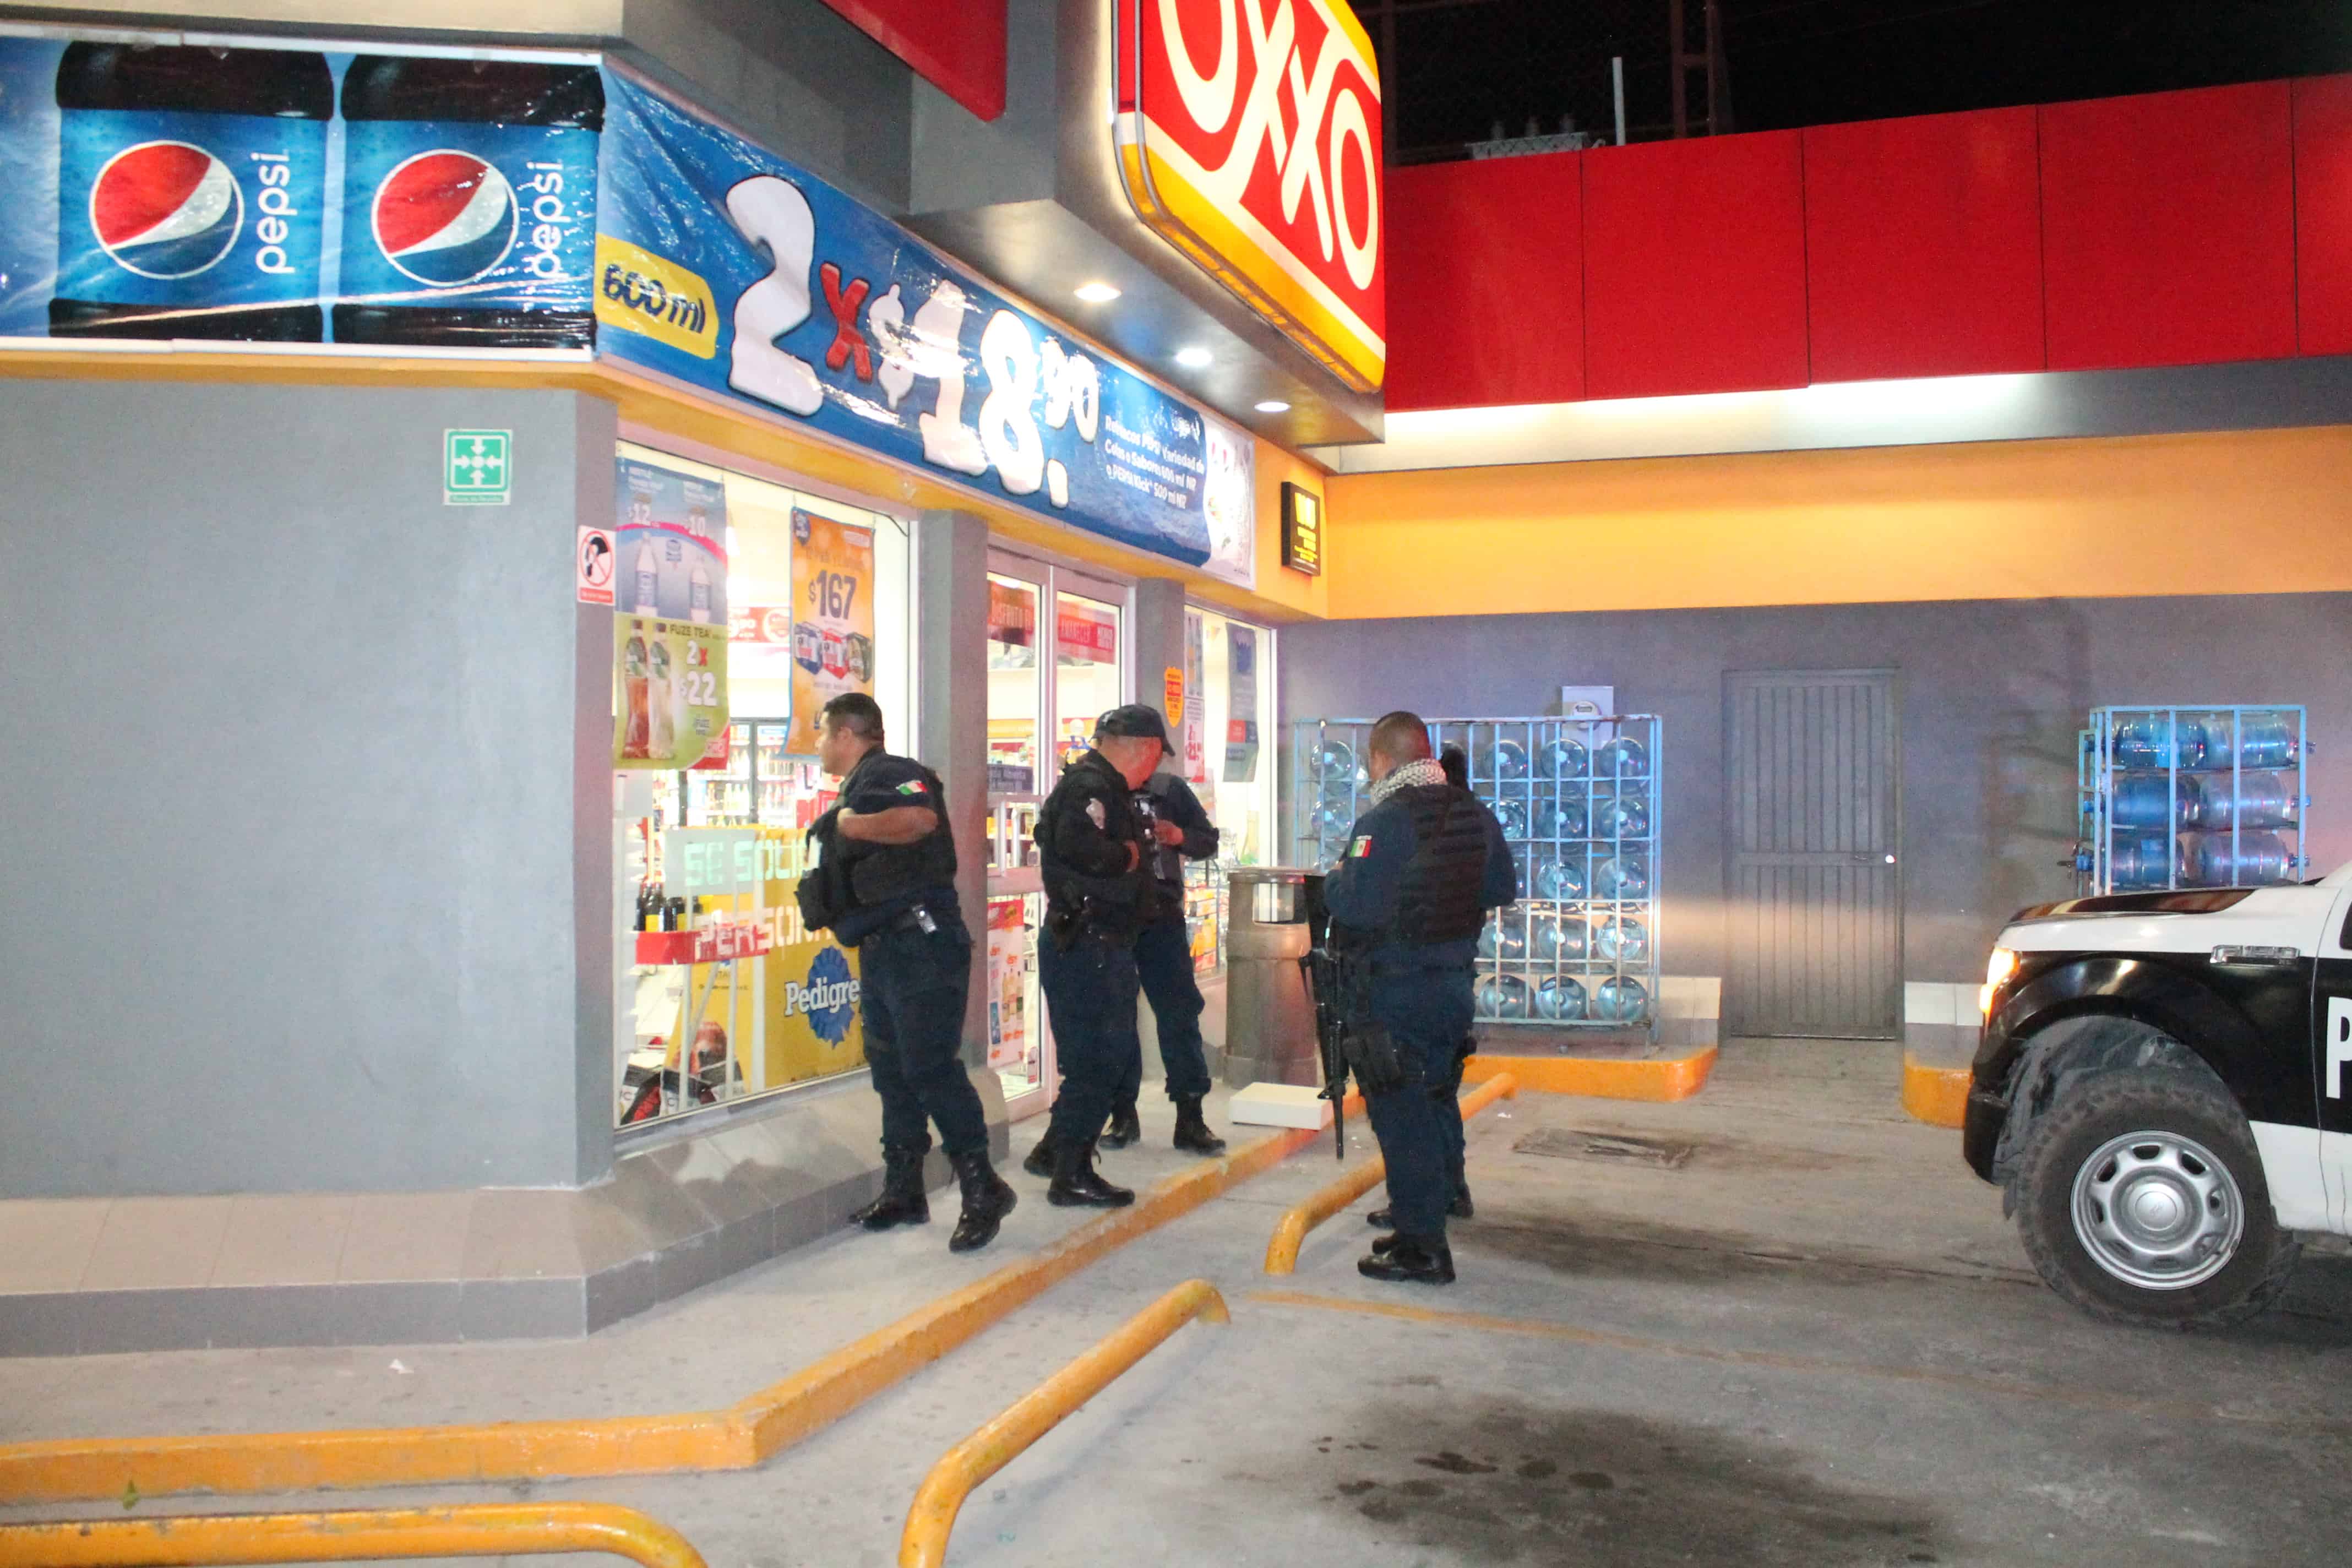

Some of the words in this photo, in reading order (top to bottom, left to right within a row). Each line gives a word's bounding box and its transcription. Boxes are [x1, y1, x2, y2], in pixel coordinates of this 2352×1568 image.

[1158, 0, 1378, 290] OXXO
[251, 153, 298, 274] pepsi
[526, 162, 571, 278] pepsi
[603, 264, 666, 317] 600
[725, 175, 824, 417] 2
[808, 569, 857, 620] $167
[784, 976, 861, 1016] Pedigre
